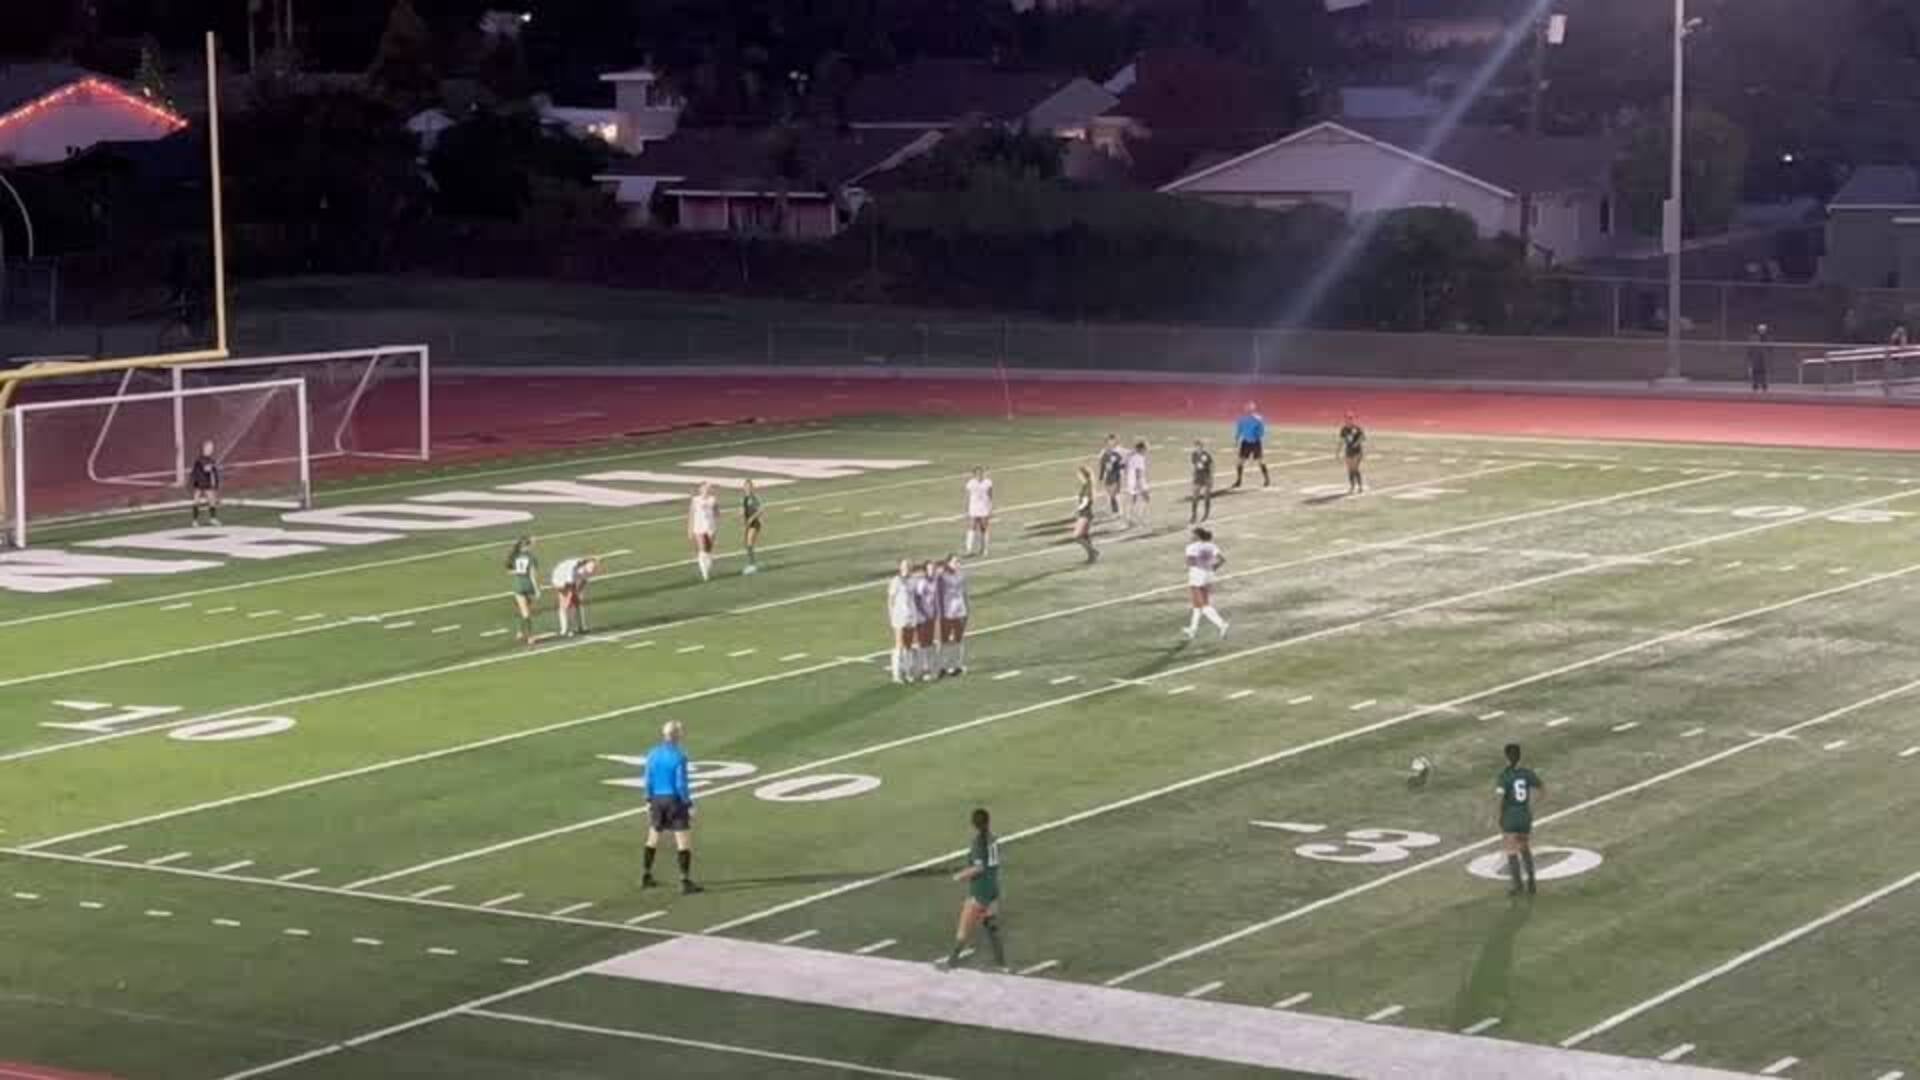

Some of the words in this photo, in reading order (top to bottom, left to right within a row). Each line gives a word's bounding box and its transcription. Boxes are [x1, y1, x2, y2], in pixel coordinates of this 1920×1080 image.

[599, 760, 882, 802] 20
[1513, 778, 1528, 802] 6
[1294, 827, 1603, 881] 30
